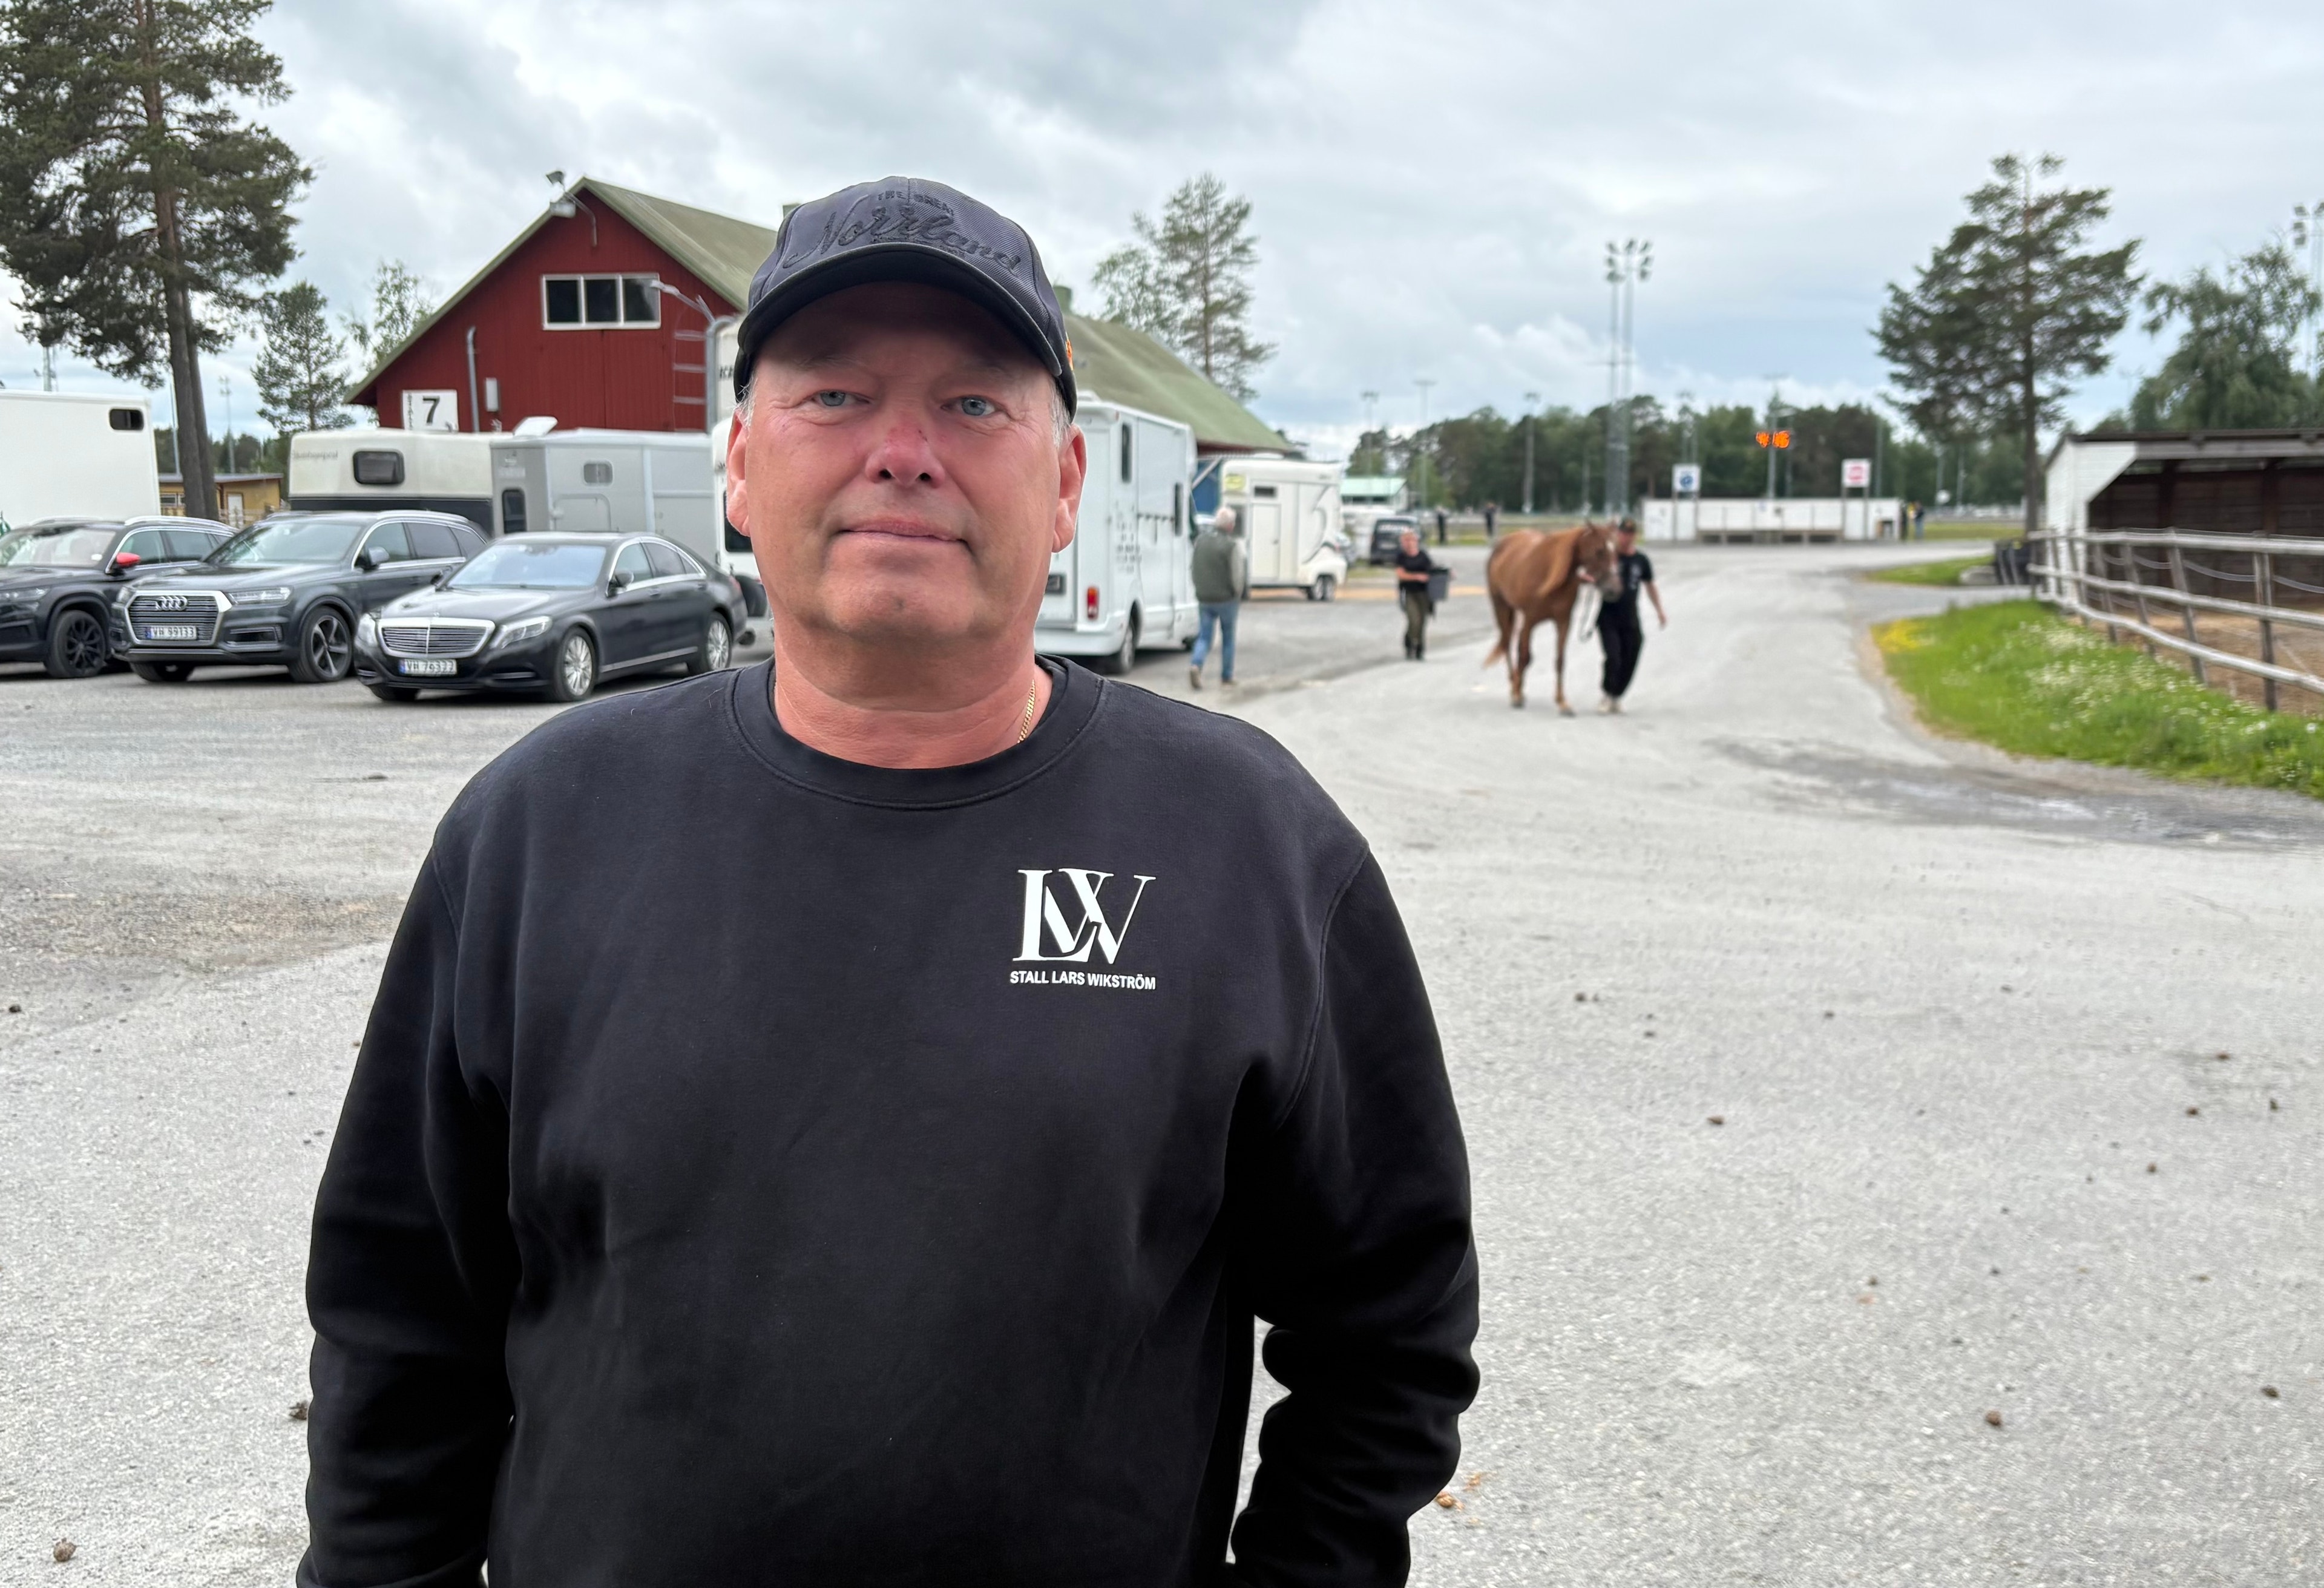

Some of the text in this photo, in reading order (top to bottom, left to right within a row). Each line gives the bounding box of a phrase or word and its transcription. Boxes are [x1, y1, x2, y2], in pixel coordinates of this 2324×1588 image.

[422, 395, 441, 425] 7
[1013, 868, 1157, 965] LW
[1009, 970, 1156, 990] STALL LARS WIKSTRÖM
